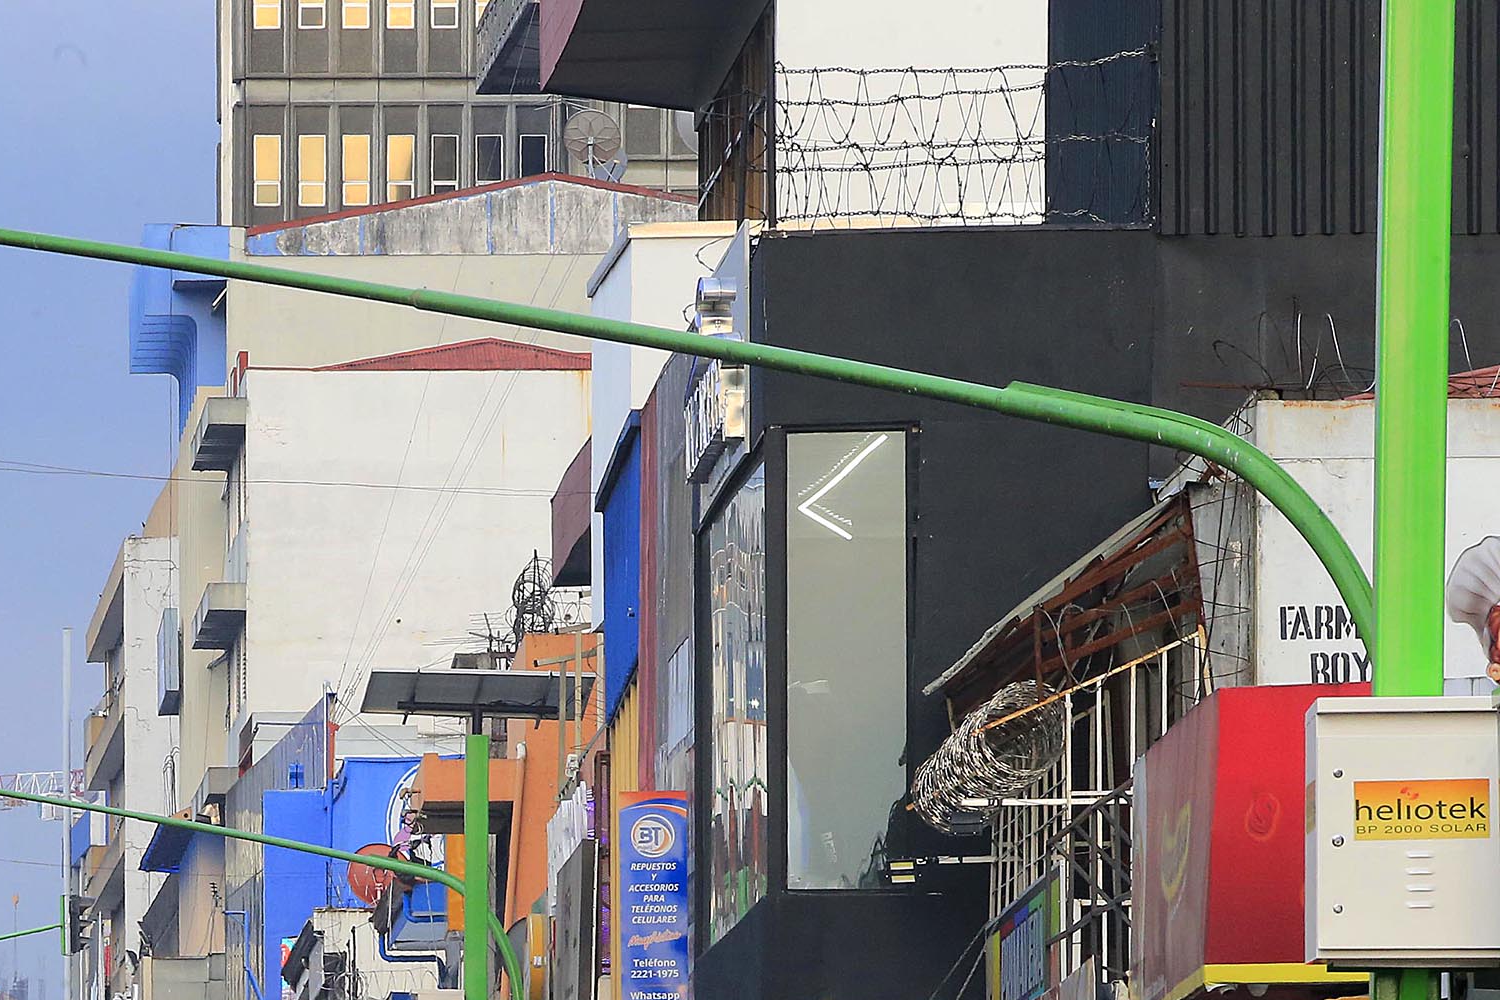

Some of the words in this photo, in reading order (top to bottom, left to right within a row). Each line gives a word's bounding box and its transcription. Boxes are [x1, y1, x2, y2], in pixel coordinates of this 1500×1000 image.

[1355, 797, 1487, 820] heliotek
[1356, 825, 1377, 834] BP
[1384, 825, 1423, 834] 2000
[1429, 823, 1487, 833] SOLAR
[630, 862, 677, 871] REPUESTOS
[651, 873, 658, 881] Y
[628, 883, 680, 892] ACCESORIOS
[643, 894, 666, 903] PARA
[631, 903, 678, 914] TELÉFONOS
[631, 915, 678, 924] CELULARES
[633, 959, 677, 968] Teléfono
[630, 969, 680, 979] 2221-1975
